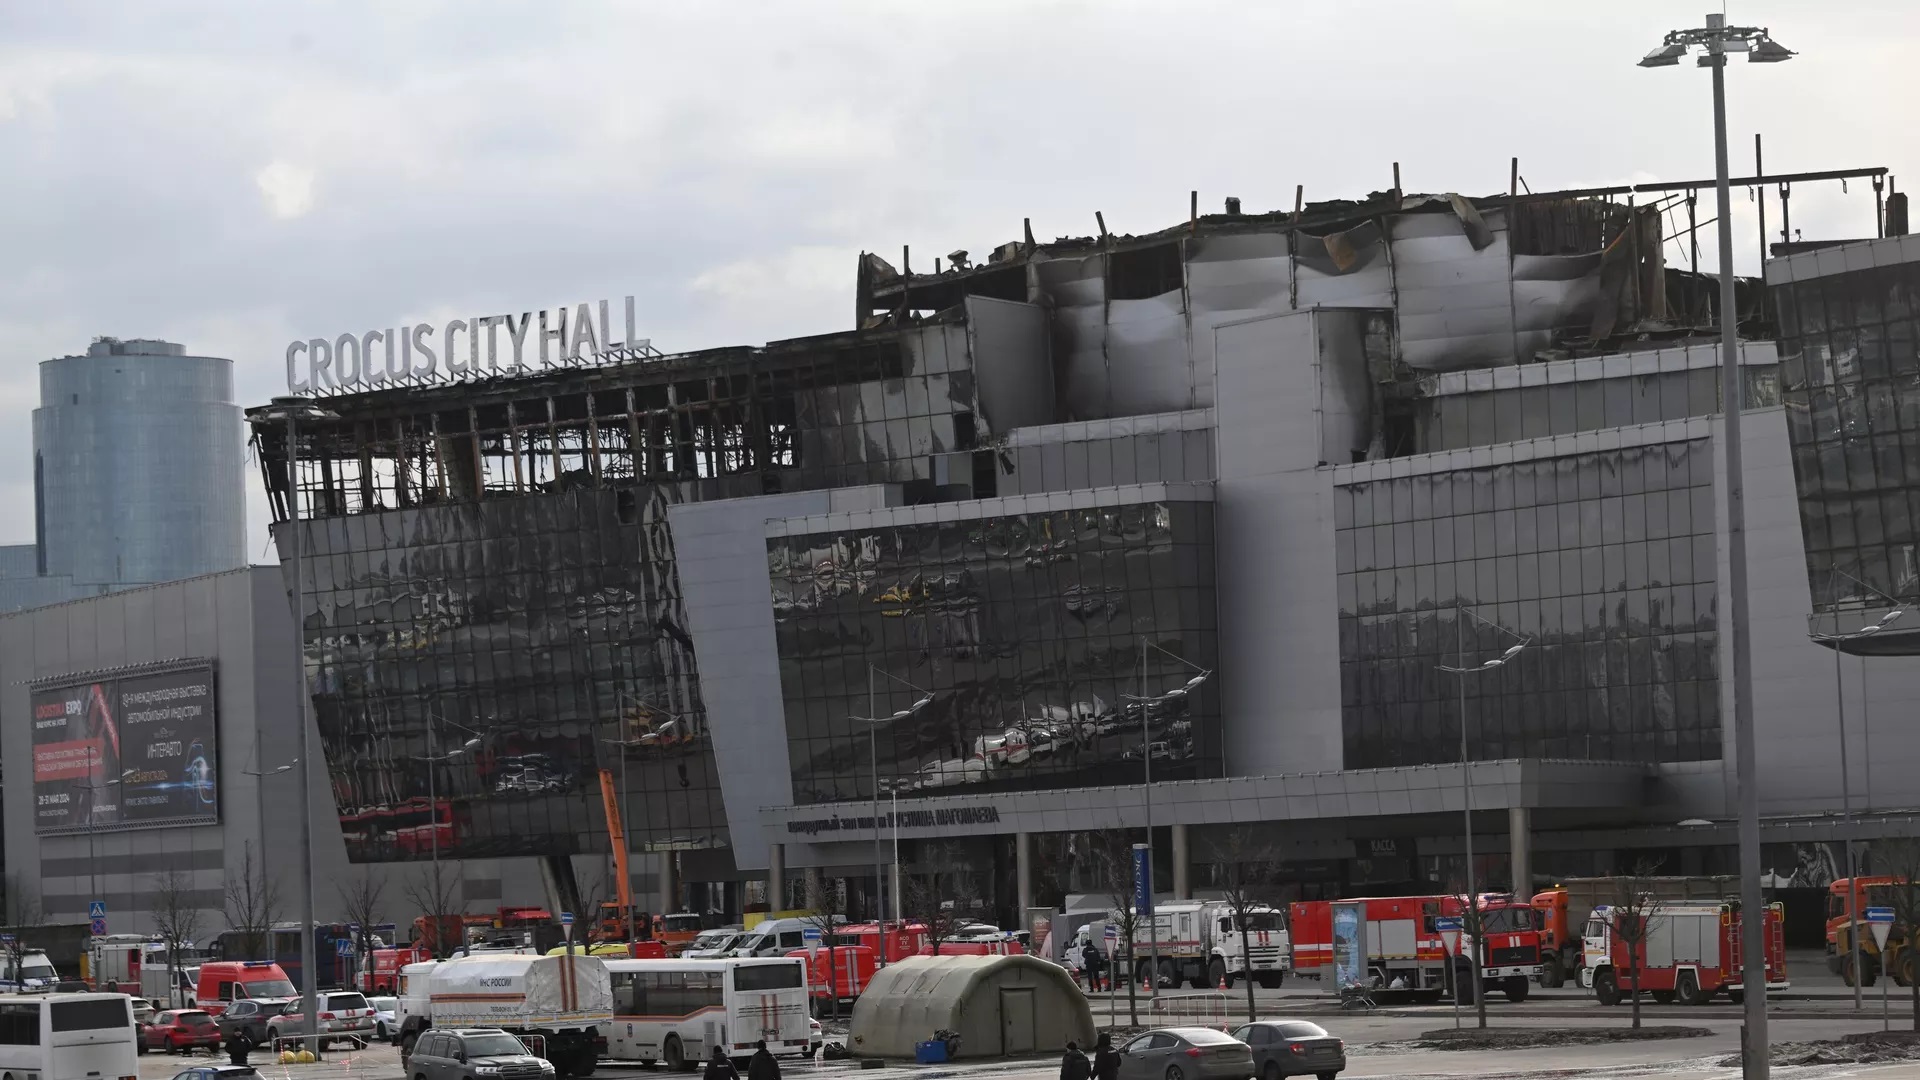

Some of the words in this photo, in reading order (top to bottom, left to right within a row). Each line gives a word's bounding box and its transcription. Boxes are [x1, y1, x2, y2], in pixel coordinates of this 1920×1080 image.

[286, 323, 436, 393] CROCUS
[445, 312, 531, 375] CITY
[539, 296, 650, 364] HALL
[134, 688, 178, 705] международная
[179, 684, 207, 698] выставка
[65, 699, 82, 715] EXPO
[127, 706, 170, 724] автомобильной
[170, 705, 202, 721] индустрии
[147, 741, 182, 759] ИНТЕРАВТО
[886, 811, 935, 828] МУСЛИМА
[936, 807, 999, 825] МАГОМАЕВА
[490, 978, 512, 987] РОССИИ
